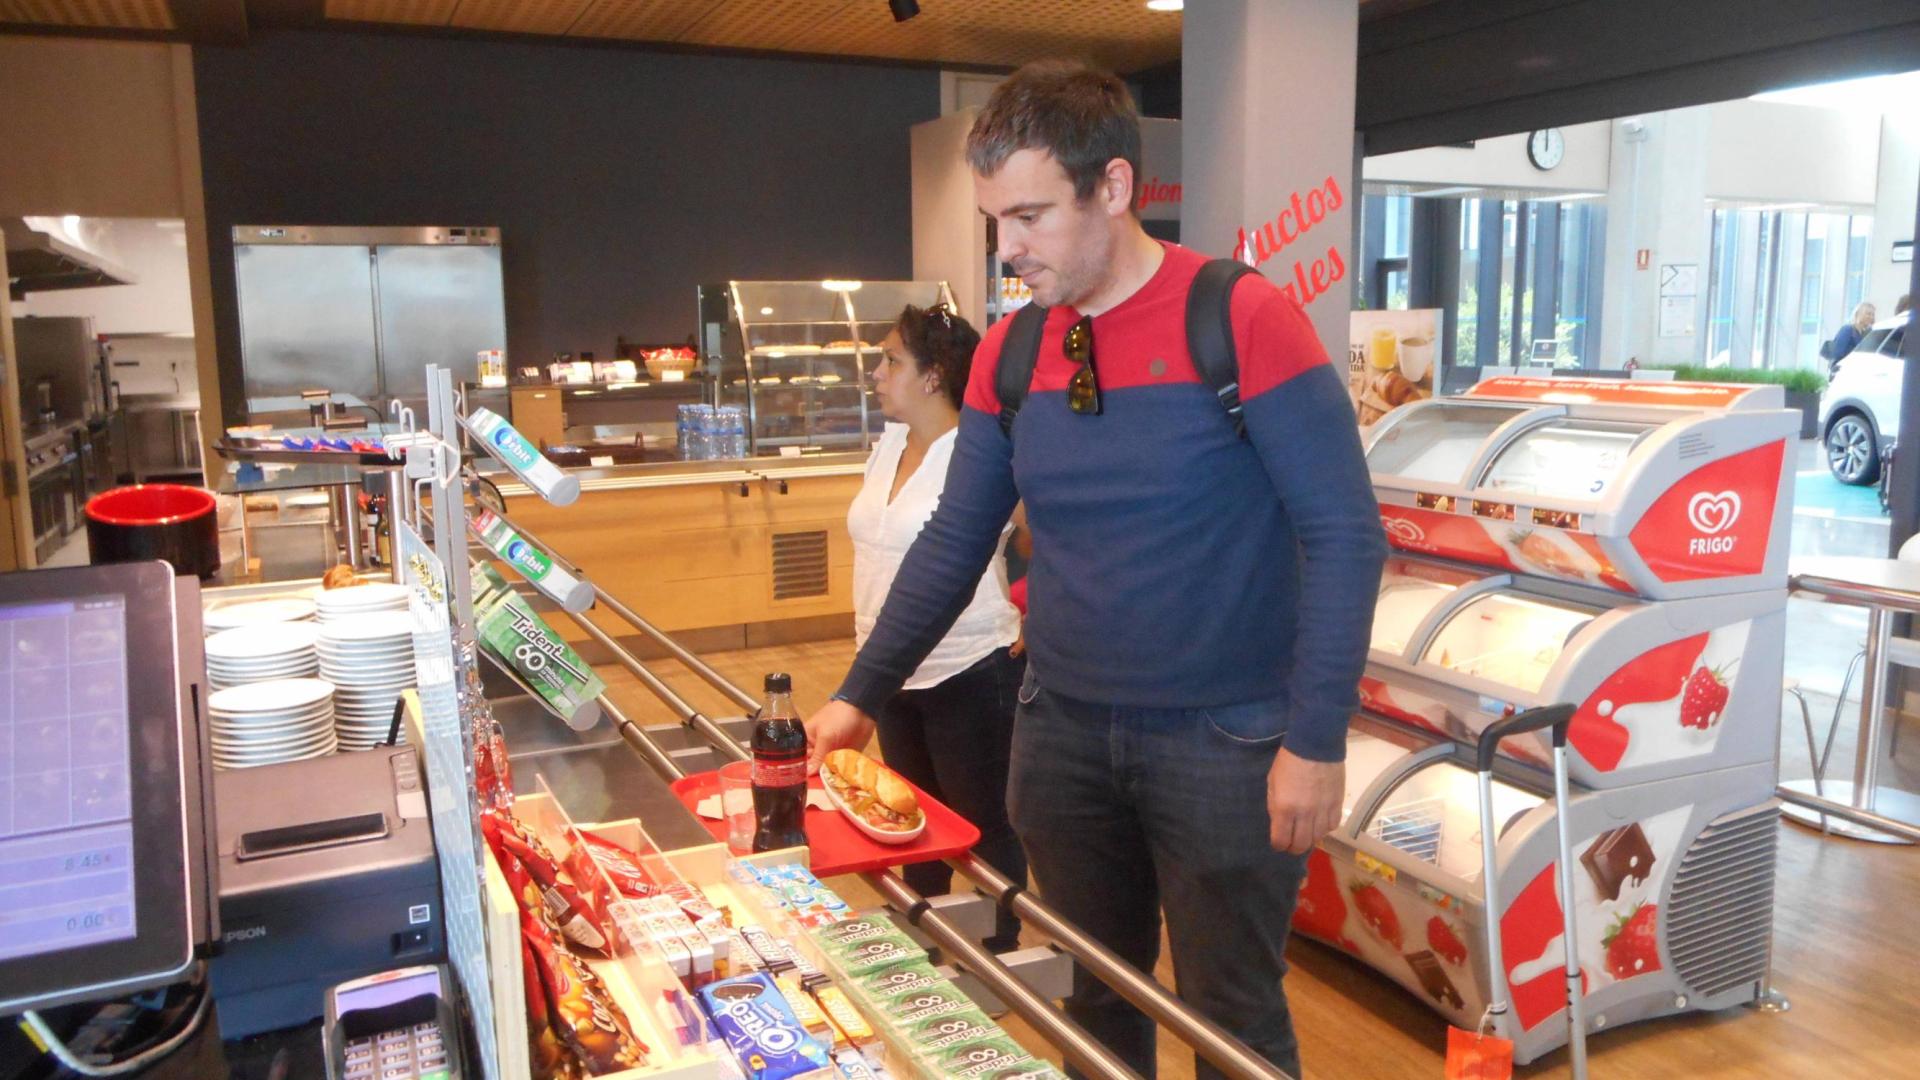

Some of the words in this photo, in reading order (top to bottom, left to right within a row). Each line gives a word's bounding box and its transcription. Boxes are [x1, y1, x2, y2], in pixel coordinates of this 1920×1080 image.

[1689, 537, 1733, 556] FRIGO
[511, 613, 566, 660] Trident
[515, 643, 546, 671] 60
[222, 926, 267, 943] PSON
[729, 1000, 798, 1051] OREO
